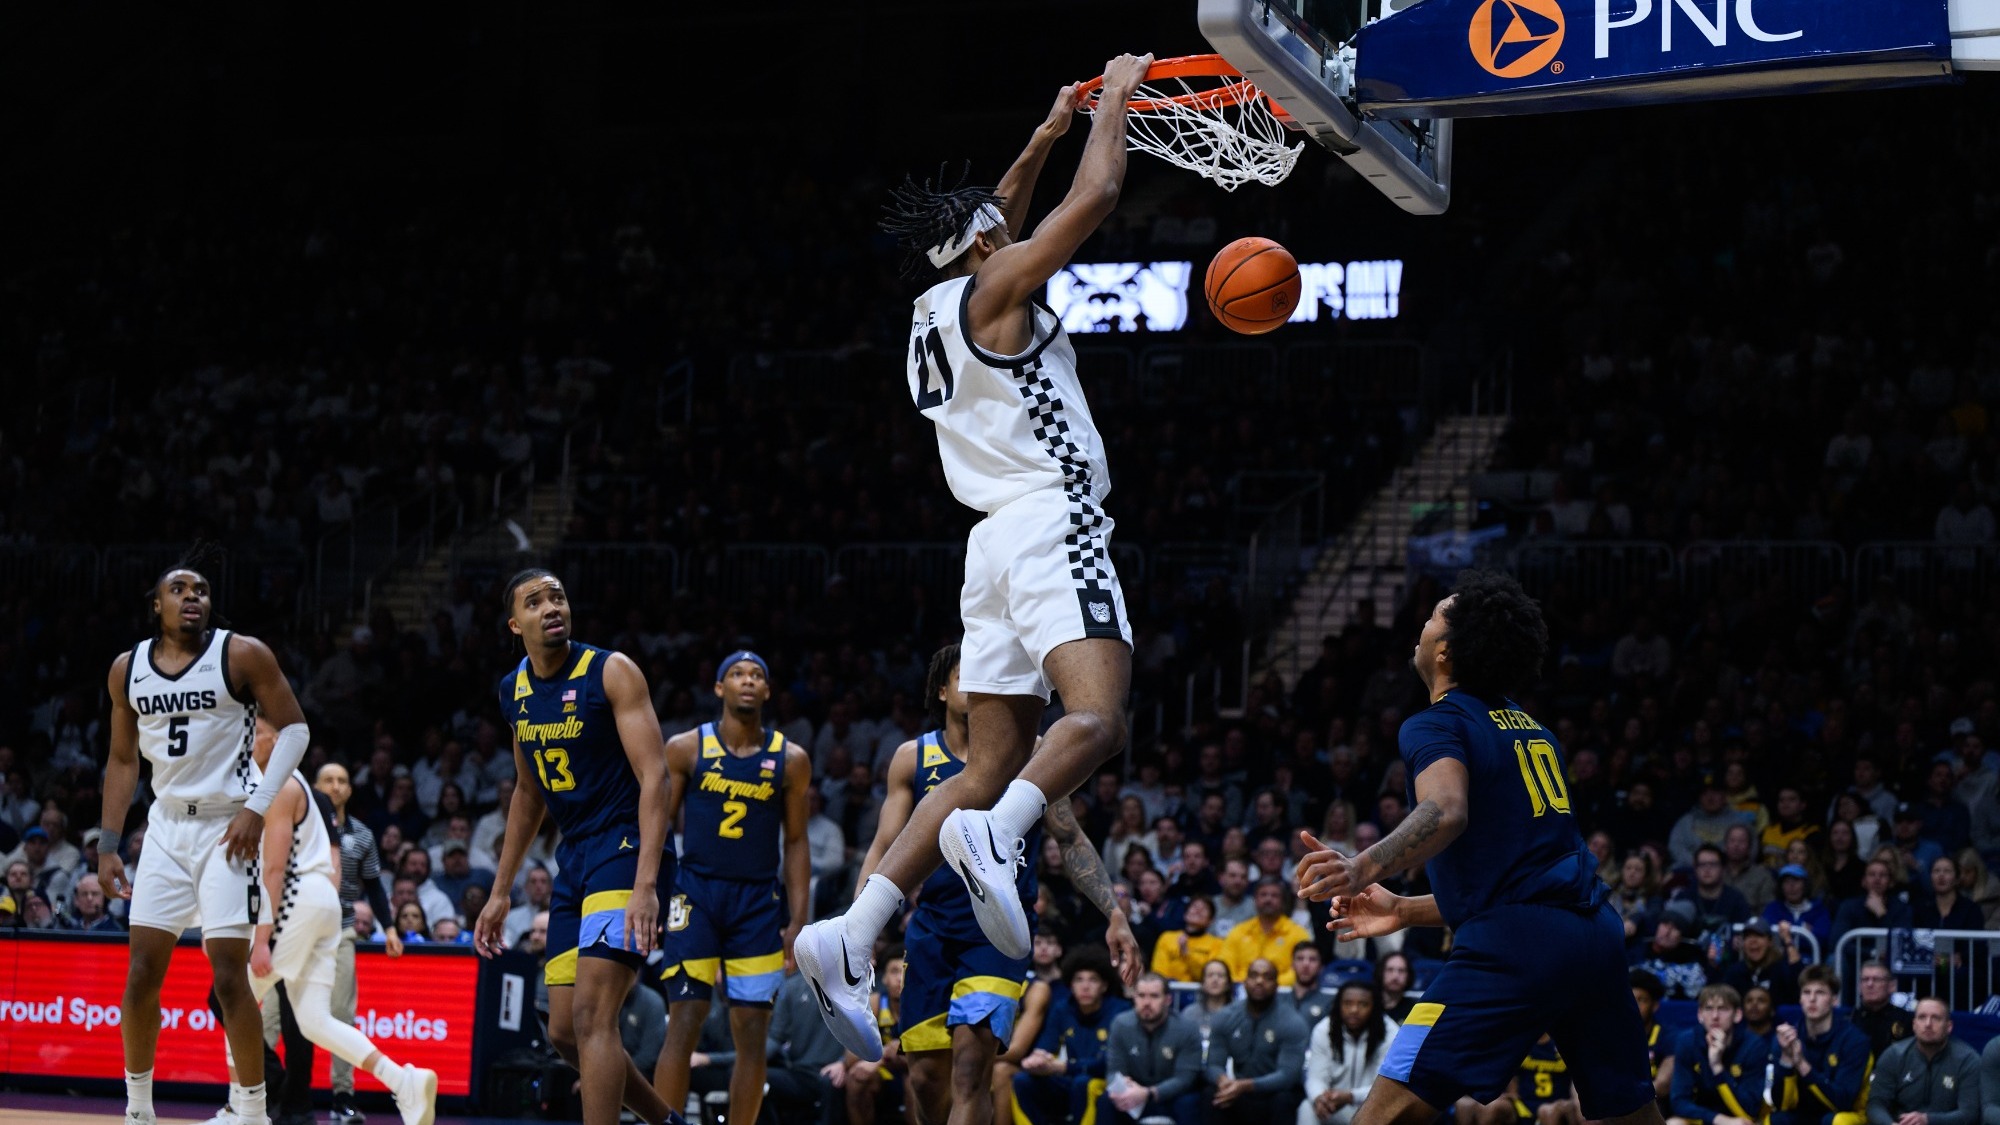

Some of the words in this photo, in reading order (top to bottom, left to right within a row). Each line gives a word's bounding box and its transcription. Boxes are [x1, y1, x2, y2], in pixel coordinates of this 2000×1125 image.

[1595, 0, 1803, 58] PNC
[915, 326, 954, 411] 21
[136, 690, 217, 715] DAWGS
[1488, 708, 1543, 731] STEVEN
[168, 716, 190, 757] 5
[516, 716, 584, 746] Marquette
[533, 748, 576, 792] 13
[700, 771, 775, 801] Marquette
[1514, 739, 1571, 817] 10
[187, 805, 197, 815] B
[719, 800, 748, 839] 2
[0, 996, 63, 1024] roud
[68, 997, 184, 1032] Spoor
